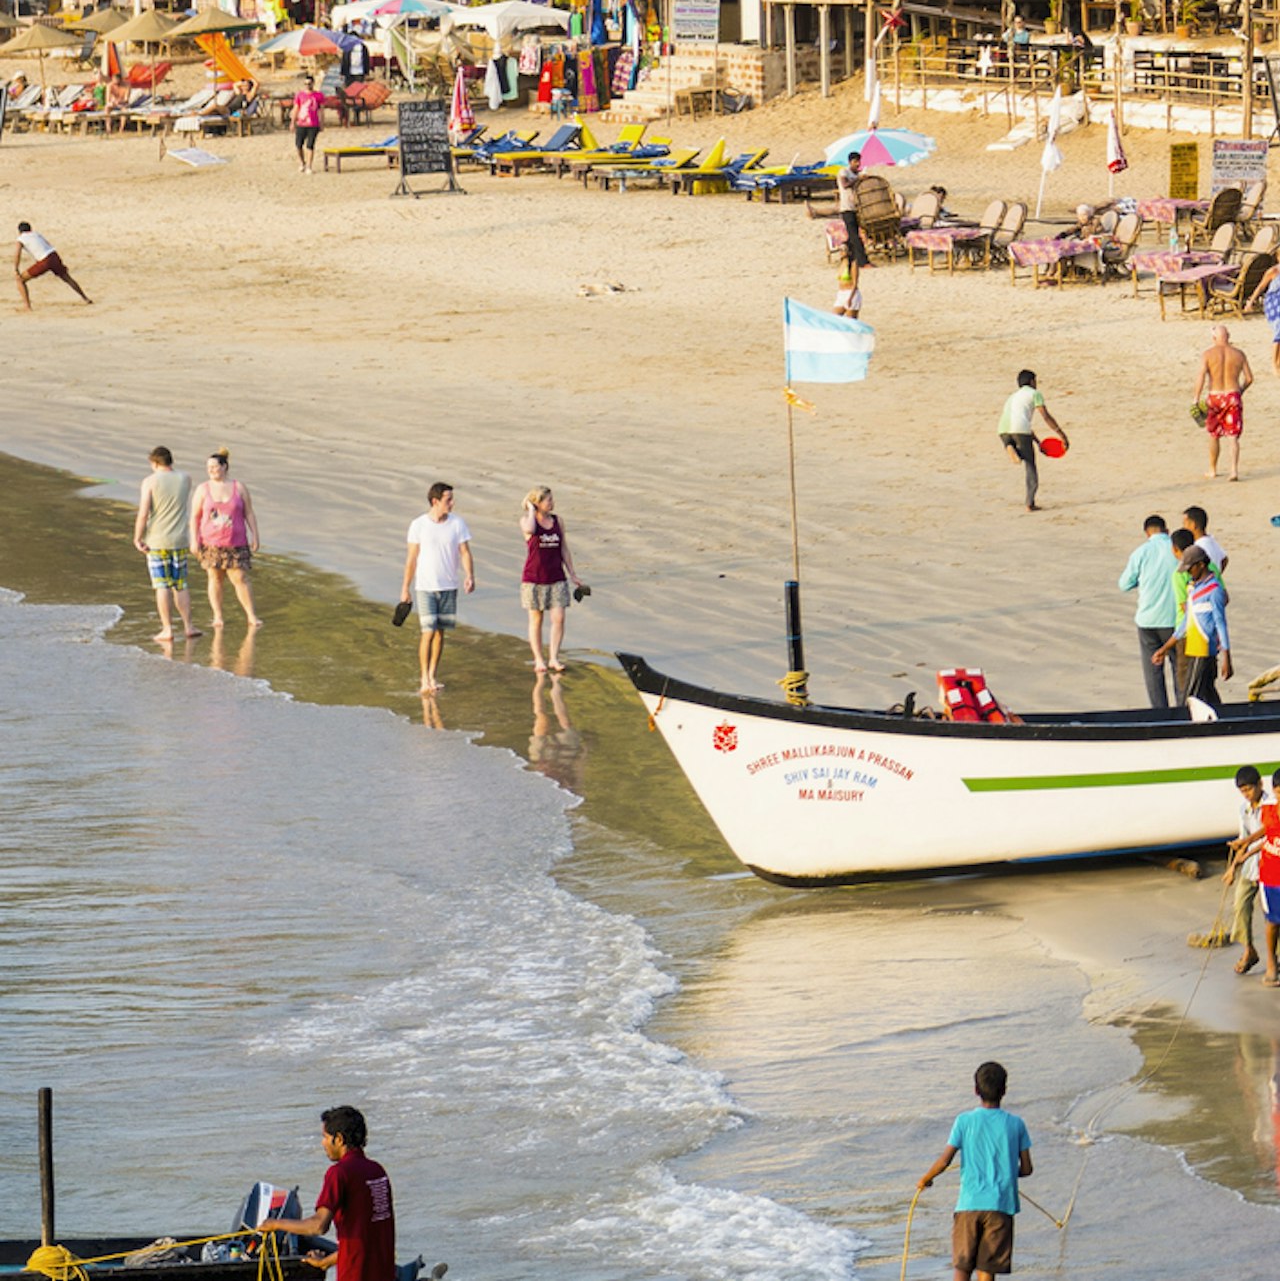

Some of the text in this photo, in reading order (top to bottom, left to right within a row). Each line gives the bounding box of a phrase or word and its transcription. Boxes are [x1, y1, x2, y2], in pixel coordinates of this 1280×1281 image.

[746, 745, 914, 781] SHREE MALLIKARJUN A PRASSAN
[784, 767, 878, 789] SHIV SAI JAY RAM
[798, 788, 815, 800] MA
